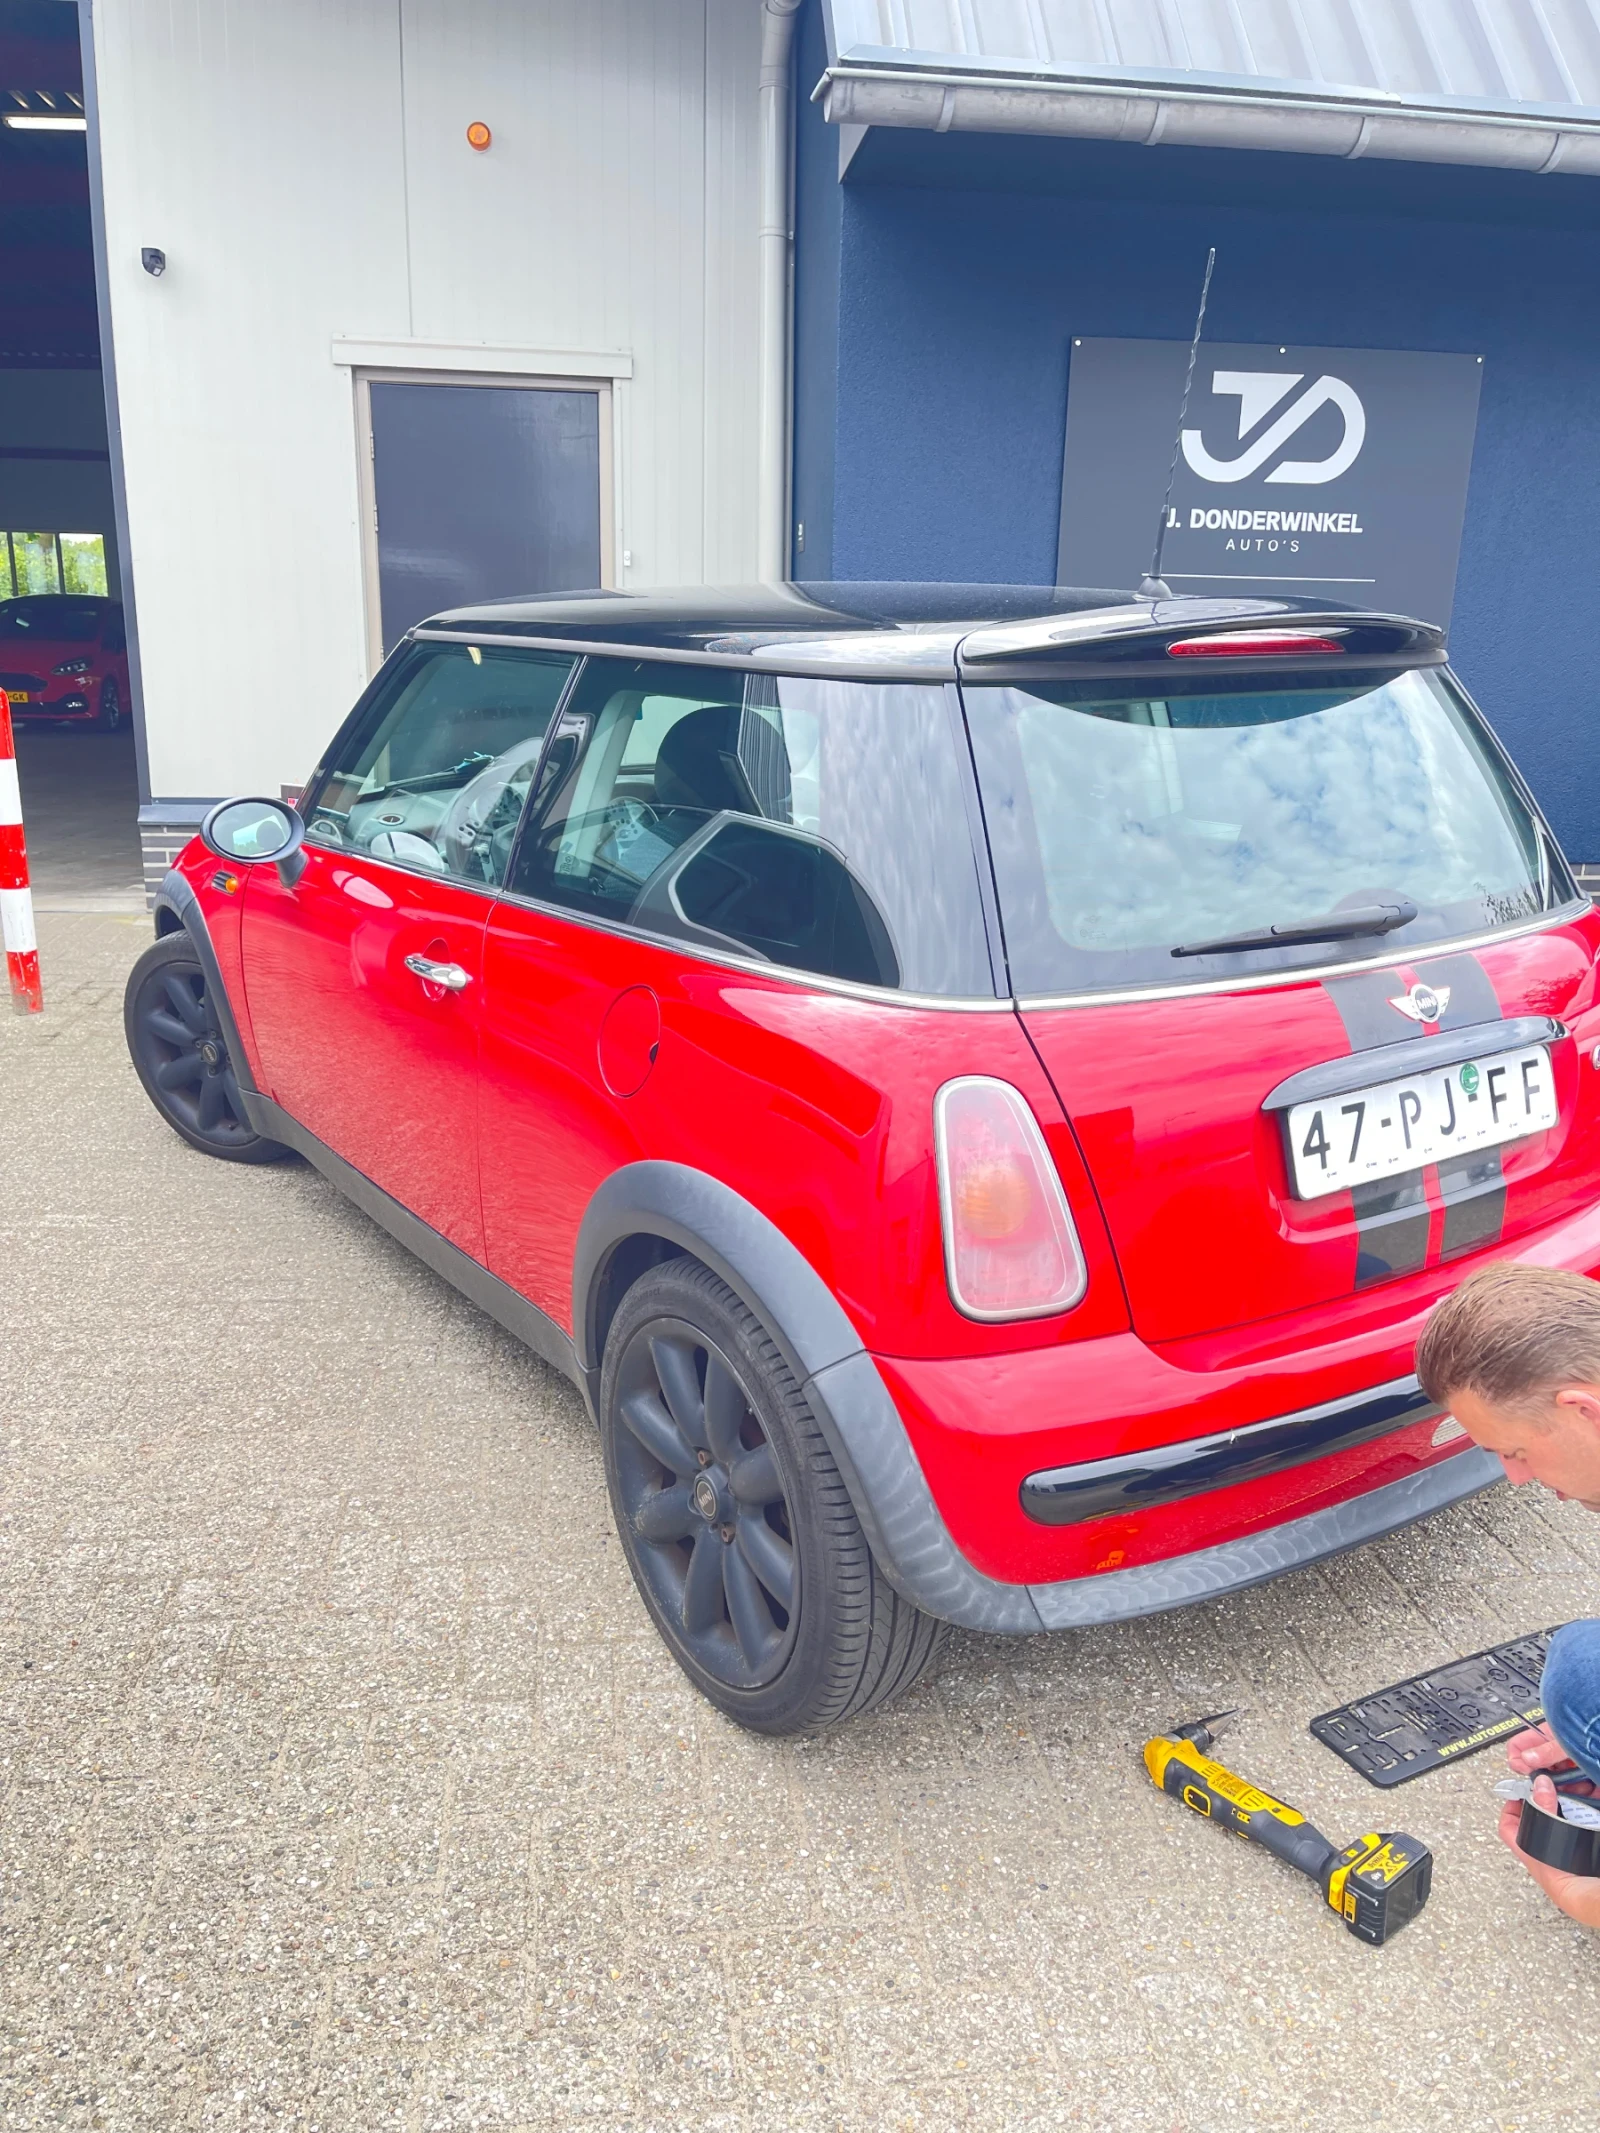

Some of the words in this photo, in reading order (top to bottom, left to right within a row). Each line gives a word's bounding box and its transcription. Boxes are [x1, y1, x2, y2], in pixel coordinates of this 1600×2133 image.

[1166, 508, 1181, 528] J.
[1190, 509, 1363, 533] DONDERWINKEL
[1226, 539, 1300, 552] AUTO'S
[1417, 995, 1438, 1010] MINI
[1302, 1058, 1541, 1170] 47-PJ-FF
